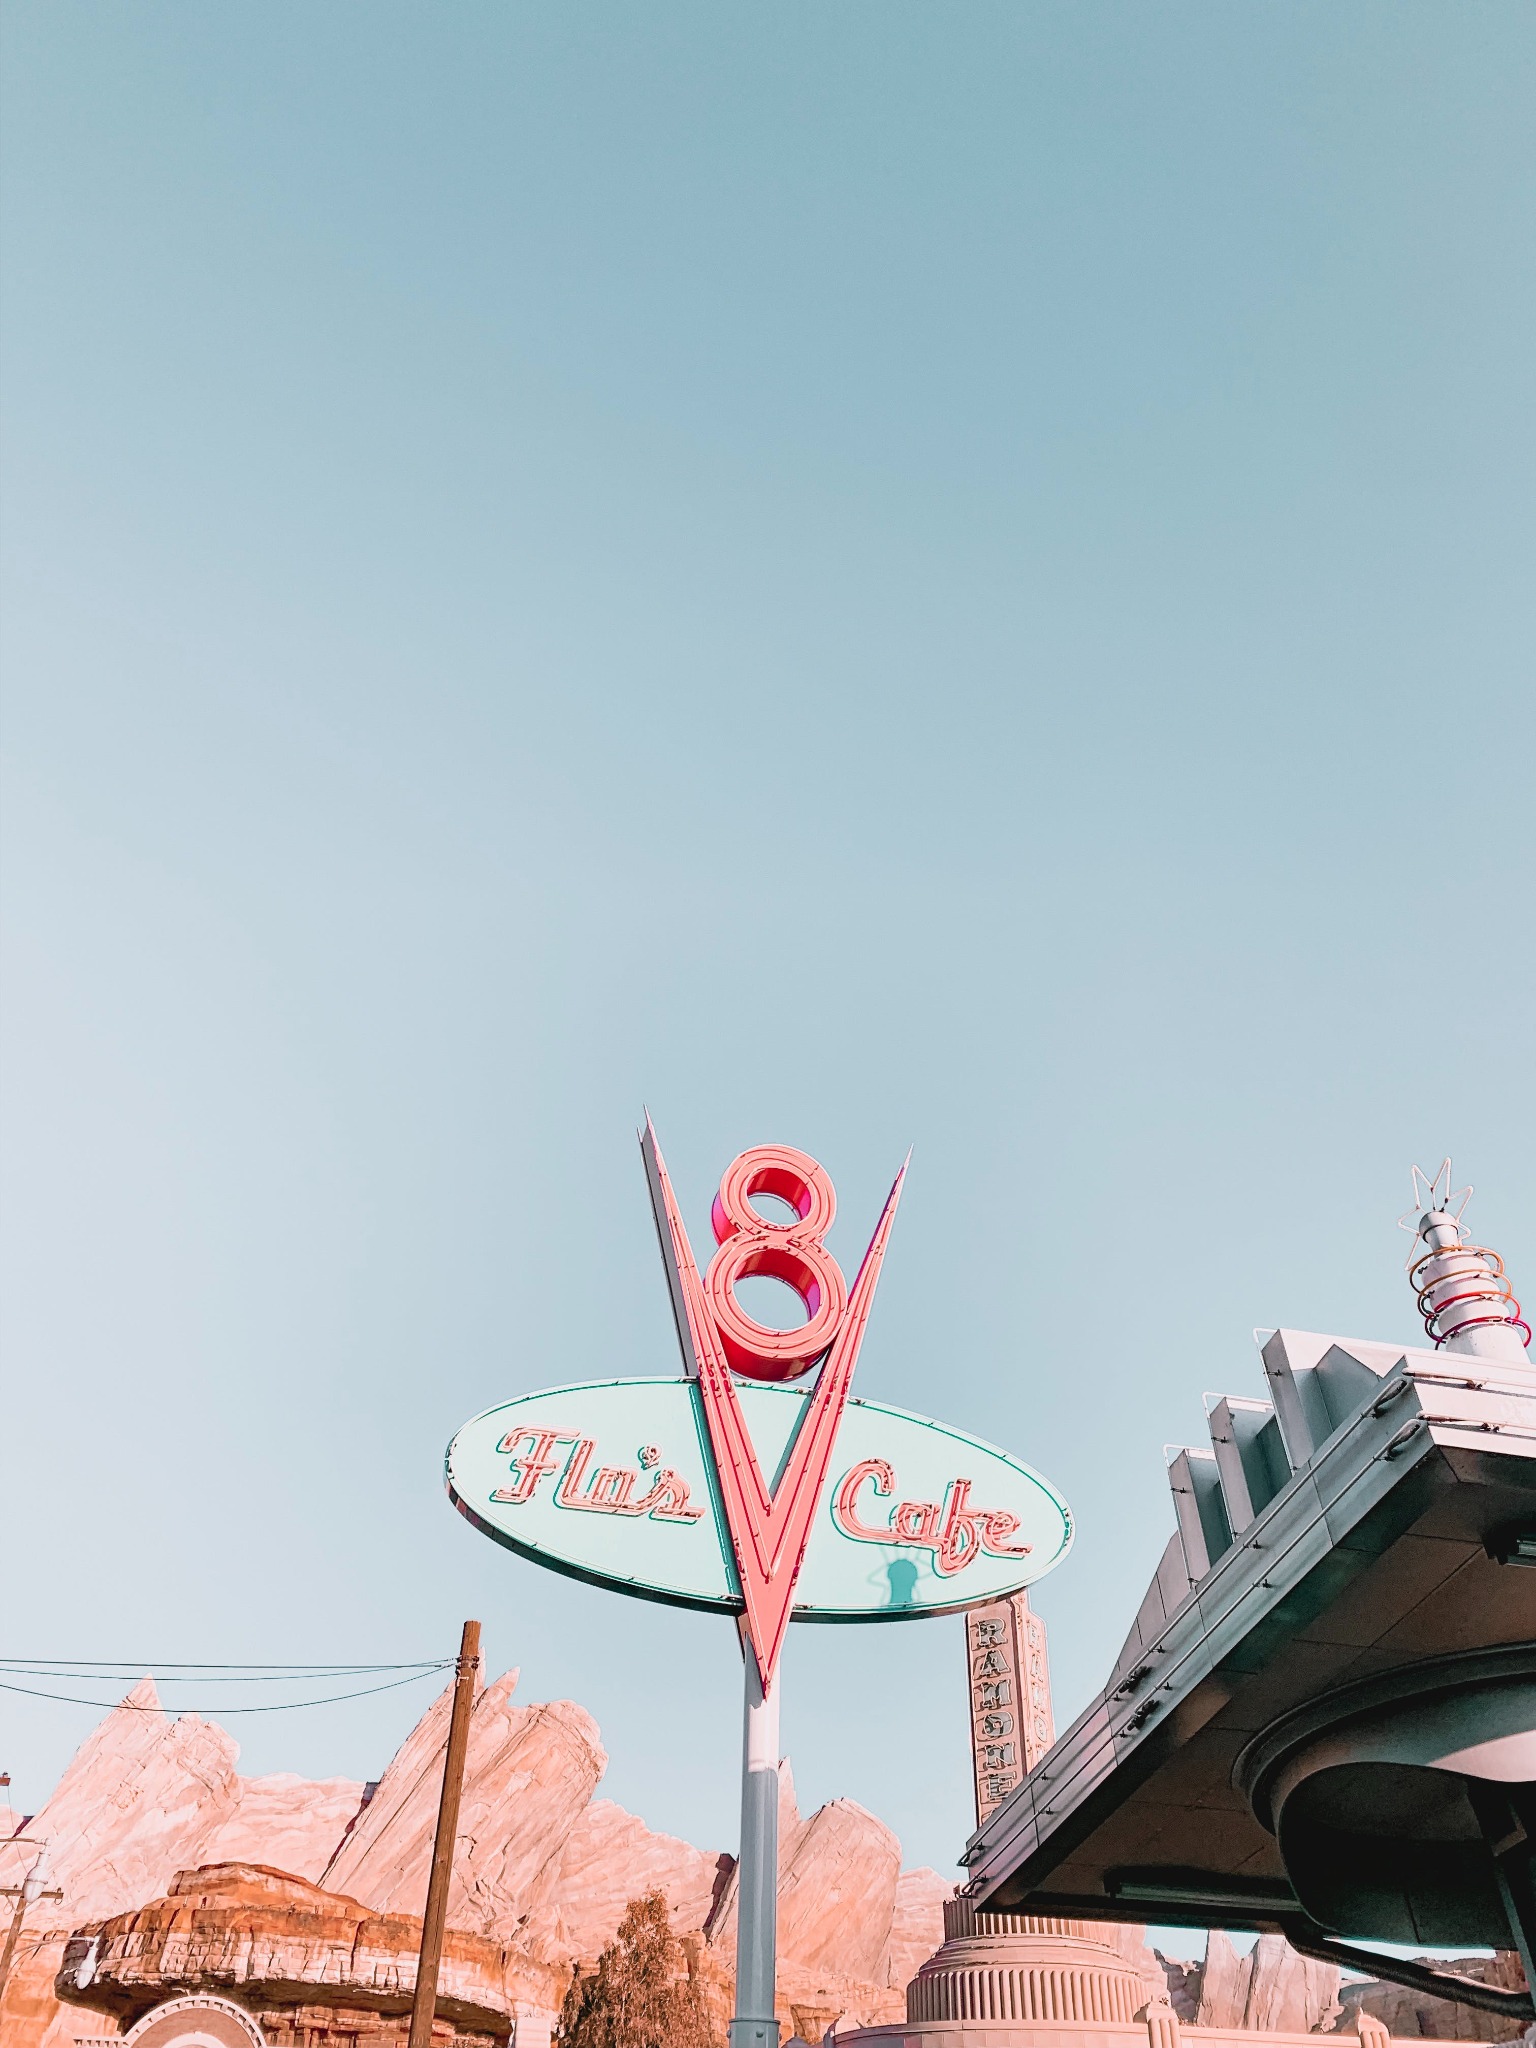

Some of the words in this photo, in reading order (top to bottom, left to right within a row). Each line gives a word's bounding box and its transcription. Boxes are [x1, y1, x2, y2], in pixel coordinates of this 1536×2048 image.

[491, 1423, 703, 1524] Flo's
[833, 1457, 1034, 1578] Cafe
[970, 1617, 1017, 1821] RAMONE
